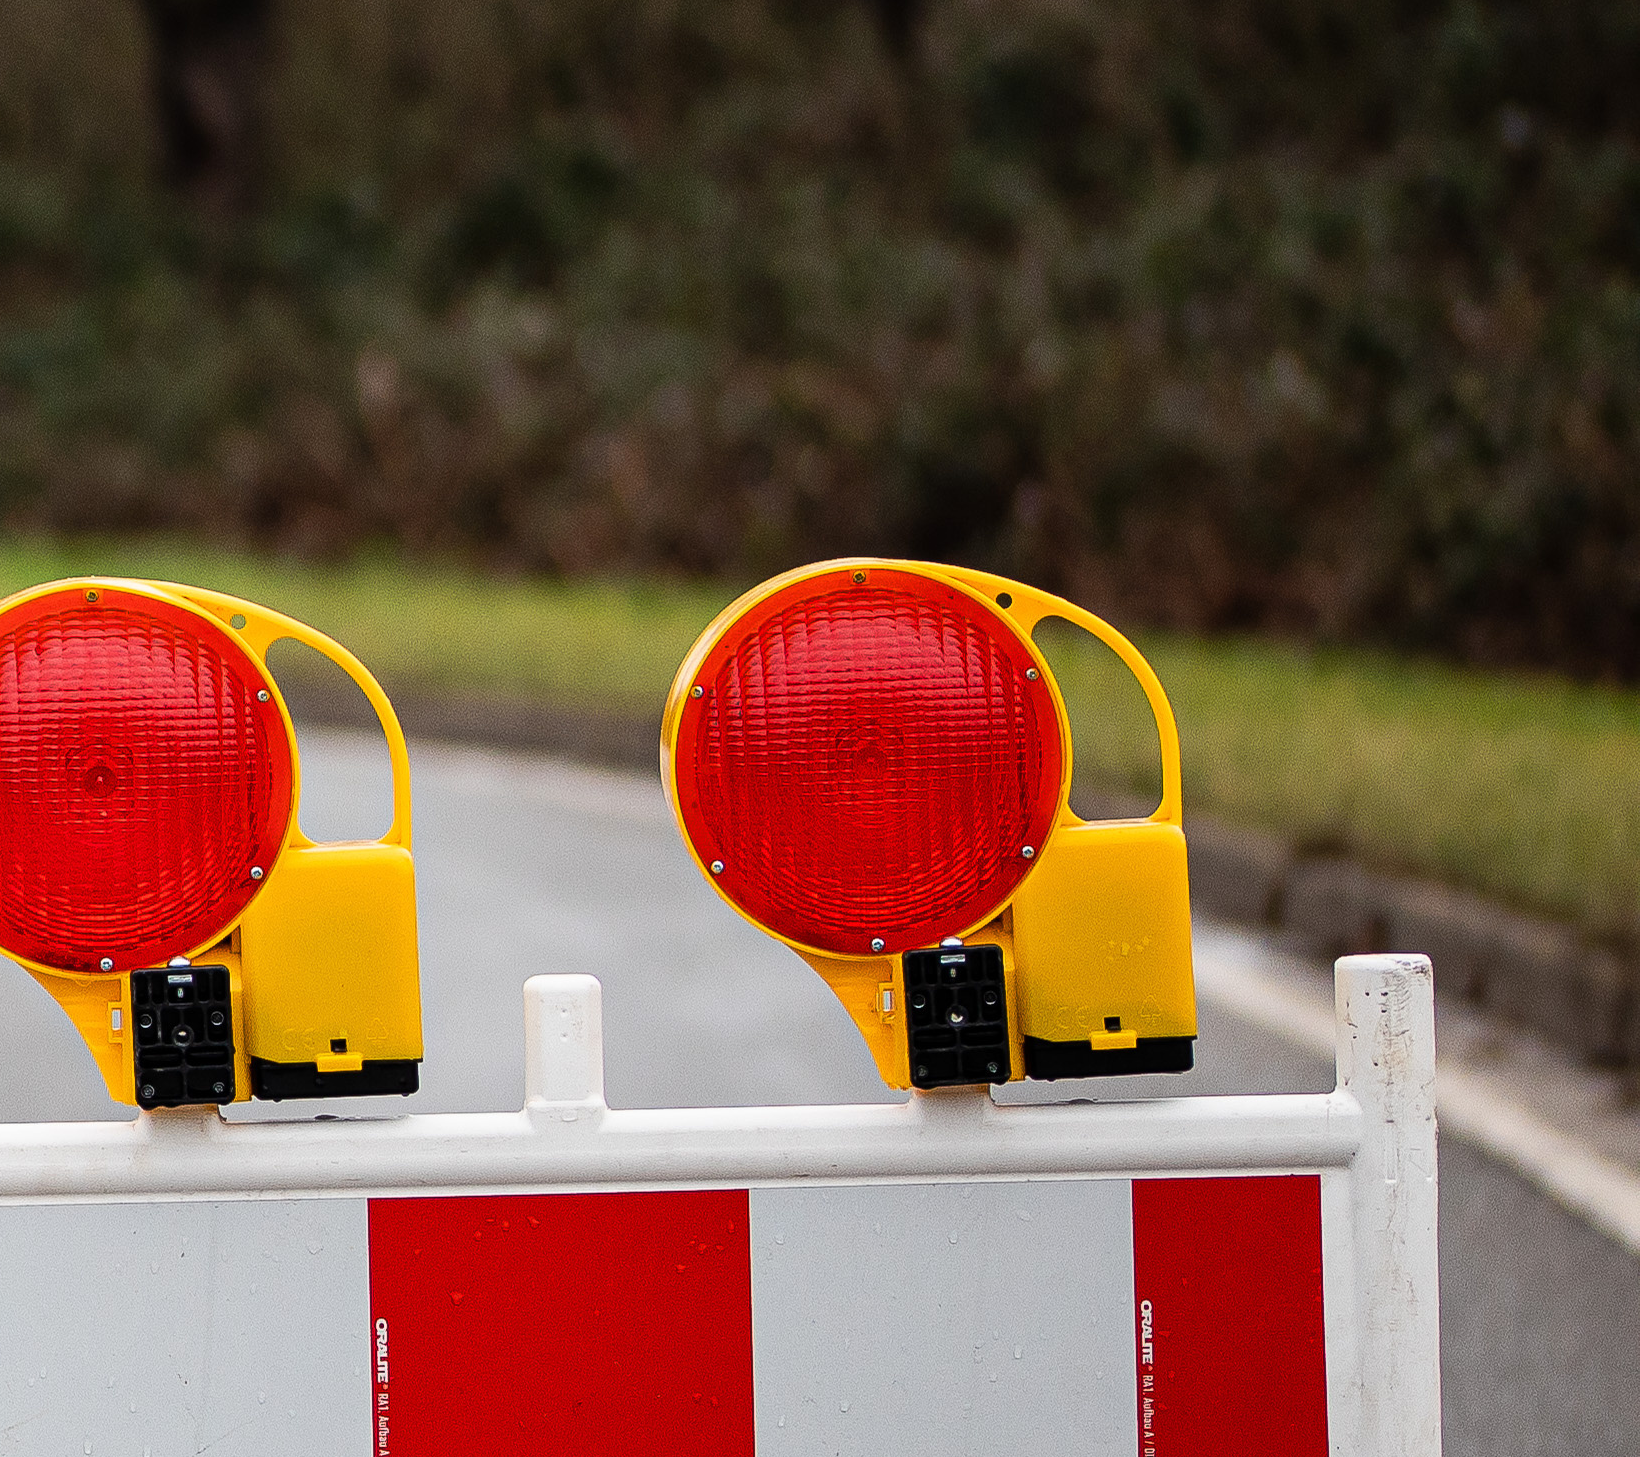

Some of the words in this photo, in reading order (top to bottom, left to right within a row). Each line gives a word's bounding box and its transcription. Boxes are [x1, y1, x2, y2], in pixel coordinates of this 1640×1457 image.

[1143, 1397, 1155, 1430] Aufbau
[378, 1415, 390, 1448] Aufbau
[1143, 1431, 1155, 1439] A
[378, 1449, 391, 1457] A
